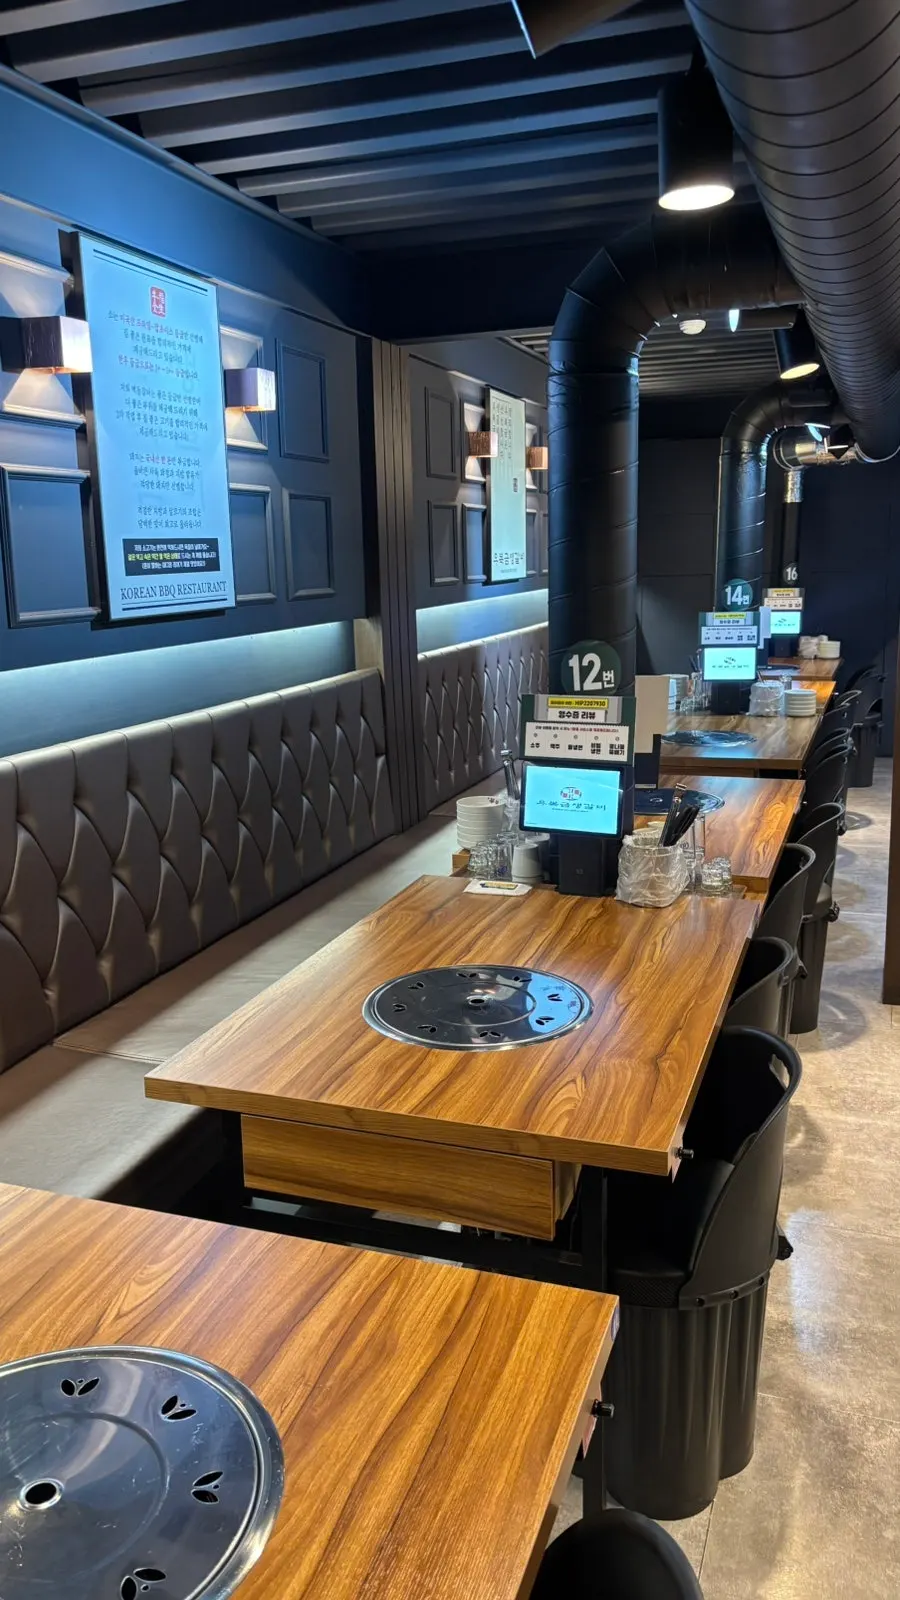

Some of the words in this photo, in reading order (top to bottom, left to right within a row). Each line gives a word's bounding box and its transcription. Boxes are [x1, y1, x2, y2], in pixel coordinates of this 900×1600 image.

[786, 567, 798, 580] 16
[120, 585, 157, 600] KOREAN
[158, 584, 176, 598] BBQ
[177, 581, 227, 596] RESTAURANT
[581, 711, 596, 720] 리뷰
